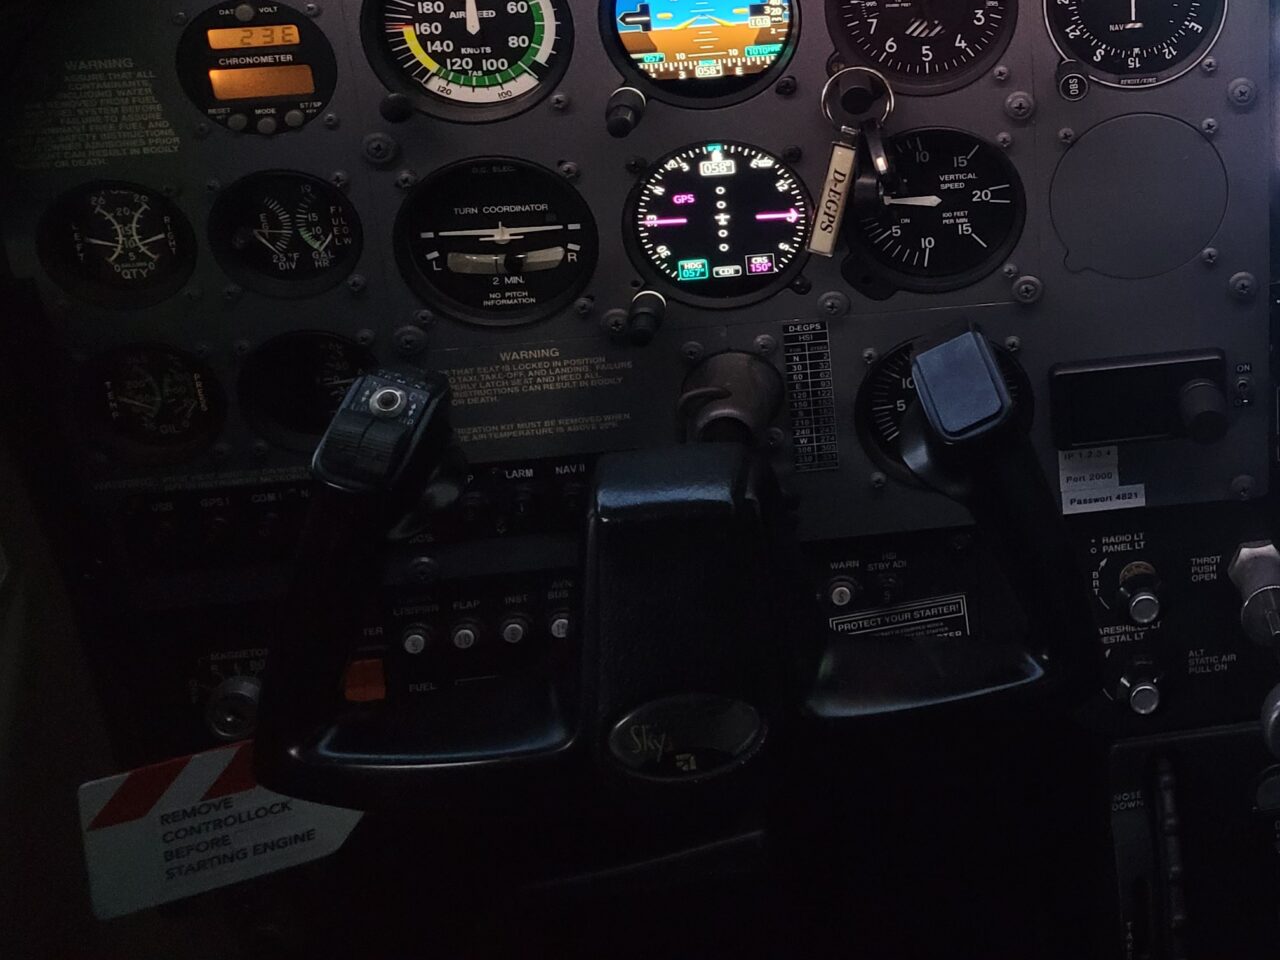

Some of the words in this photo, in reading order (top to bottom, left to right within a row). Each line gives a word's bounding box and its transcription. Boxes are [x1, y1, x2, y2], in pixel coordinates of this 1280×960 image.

[417, 1, 444, 14] 180
[507, 2, 527, 14] 60
[415, 22, 441, 35] 160
[1065, 25, 1080, 38] 21
[427, 40, 454, 52] 140
[508, 36, 529, 48] 80
[1163, 46, 1177, 59] 12
[65, 58, 135, 71] WARNING
[218, 54, 293, 66] CHRONOMETER
[447, 58, 472, 70] 120
[482, 59, 508, 71] 100
[1128, 58, 1141, 68] 15
[1069, 78, 1078, 95] OBS
[916, 151, 929, 163] 10
[954, 156, 967, 167] 15
[939, 173, 977, 181] VERTICAL
[940, 182, 965, 190] SPEED
[673, 194, 695, 204] GPS
[820, 169, 846, 234] D-EGPS
[972, 190, 991, 202] 20
[454, 207, 478, 215] TURN
[482, 204, 548, 214] COORDINATOR
[958, 223, 972, 235] 15
[921, 237, 935, 248] 10
[121, 268, 148, 279] QTY
[504, 276, 525, 284] MIN.
[483, 297, 536, 306] INFORMATION
[788, 324, 821, 332] D-EGPS
[500, 348, 559, 362] WARNING
[513, 362, 549, 371] LOCKED
[517, 421, 542, 429] MUST
[559, 416, 602, 425] REMOVED
[1089, 472, 1112, 481] 2000
[200, 497, 224, 507] GPS
[1070, 496, 1112, 505] Passwort
[1102, 534, 1132, 544] RADIO
[1102, 544, 1132, 553] PANEL
[830, 560, 860, 569] WARN
[1190, 556, 1222, 566] THROT
[1192, 564, 1216, 574] PUSH
[1192, 572, 1217, 582] OPEN
[453, 600, 480, 610] FLAP
[504, 594, 529, 605] INST
[838, 618, 881, 632] PROTECT
[884, 613, 911, 623] YOUR
[914, 603, 959, 618] STARTER!
[1188, 650, 1204, 658] ALT
[1188, 657, 1218, 666] STATIC
[1222, 654, 1236, 663] AIR
[1188, 665, 1212, 674] PULL
[1214, 664, 1228, 672] ON
[409, 683, 434, 692] FUEL
[1113, 790, 1143, 802] NOSE
[1112, 799, 1144, 811] DOWN
[160, 798, 233, 825] REMOVE
[162, 800, 292, 843] CONTROLLOCK
[164, 835, 231, 862] BEFORE
[166, 848, 248, 880] STARTING
[252, 829, 316, 856] ENGINE
